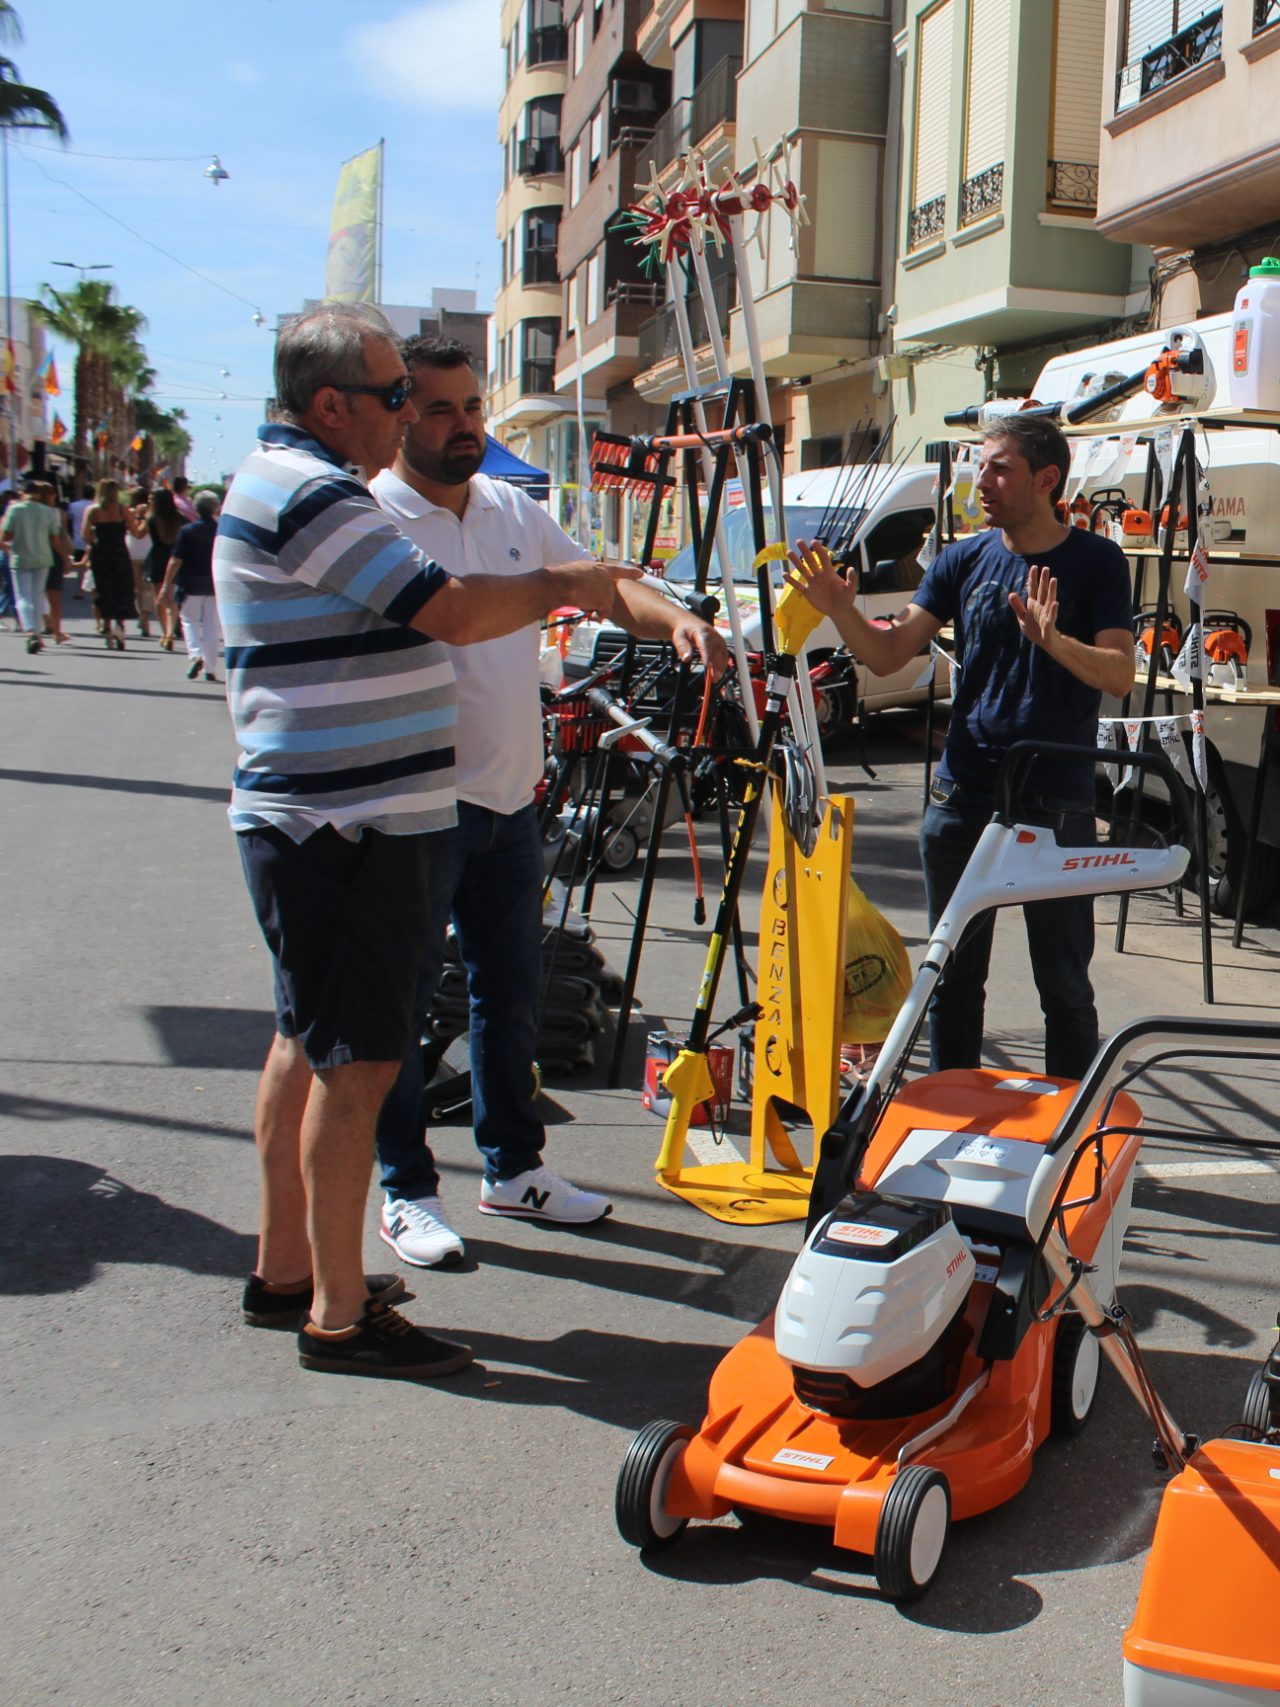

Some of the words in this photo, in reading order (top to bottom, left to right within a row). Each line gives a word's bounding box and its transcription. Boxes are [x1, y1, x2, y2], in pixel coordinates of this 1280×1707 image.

[1062, 852, 1136, 871] STIHL
[767, 917, 788, 1026] BENZA
[520, 1185, 551, 1210] N
[839, 1225, 884, 1237] STIHL
[946, 1248, 967, 1279] STIHL
[779, 1452, 824, 1465] STIHL
